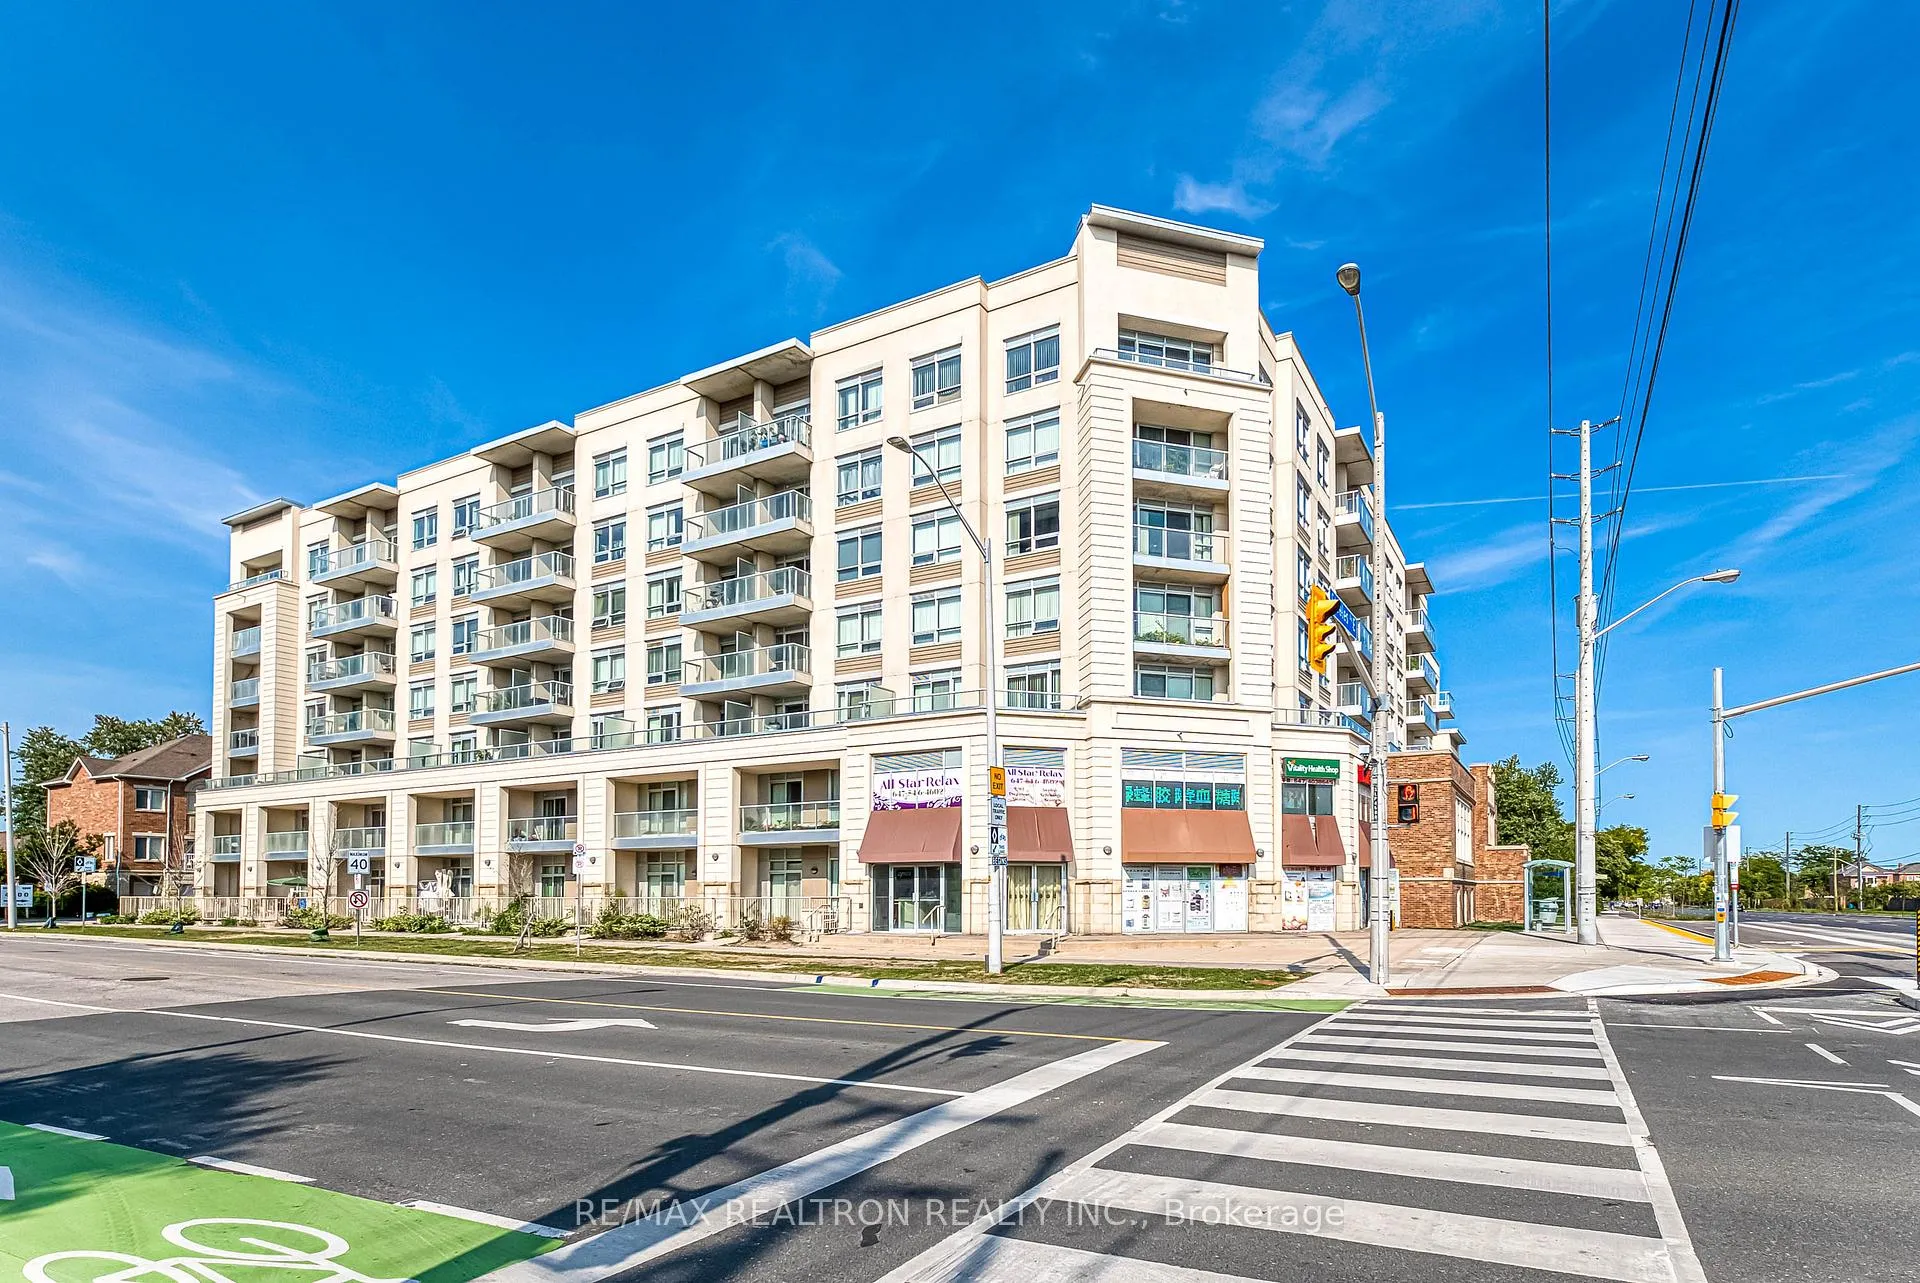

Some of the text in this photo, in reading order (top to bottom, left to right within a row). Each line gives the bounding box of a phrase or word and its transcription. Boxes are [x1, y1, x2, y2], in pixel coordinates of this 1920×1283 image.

[1007, 768, 1063, 778] All Star Relax
[1287, 763, 1339, 775] Vitality Health Shop
[880, 775, 960, 790] All Star Relax
[994, 773, 1002, 781] NO
[992, 782, 1004, 790] EXIT
[350, 858, 368, 870] 40
